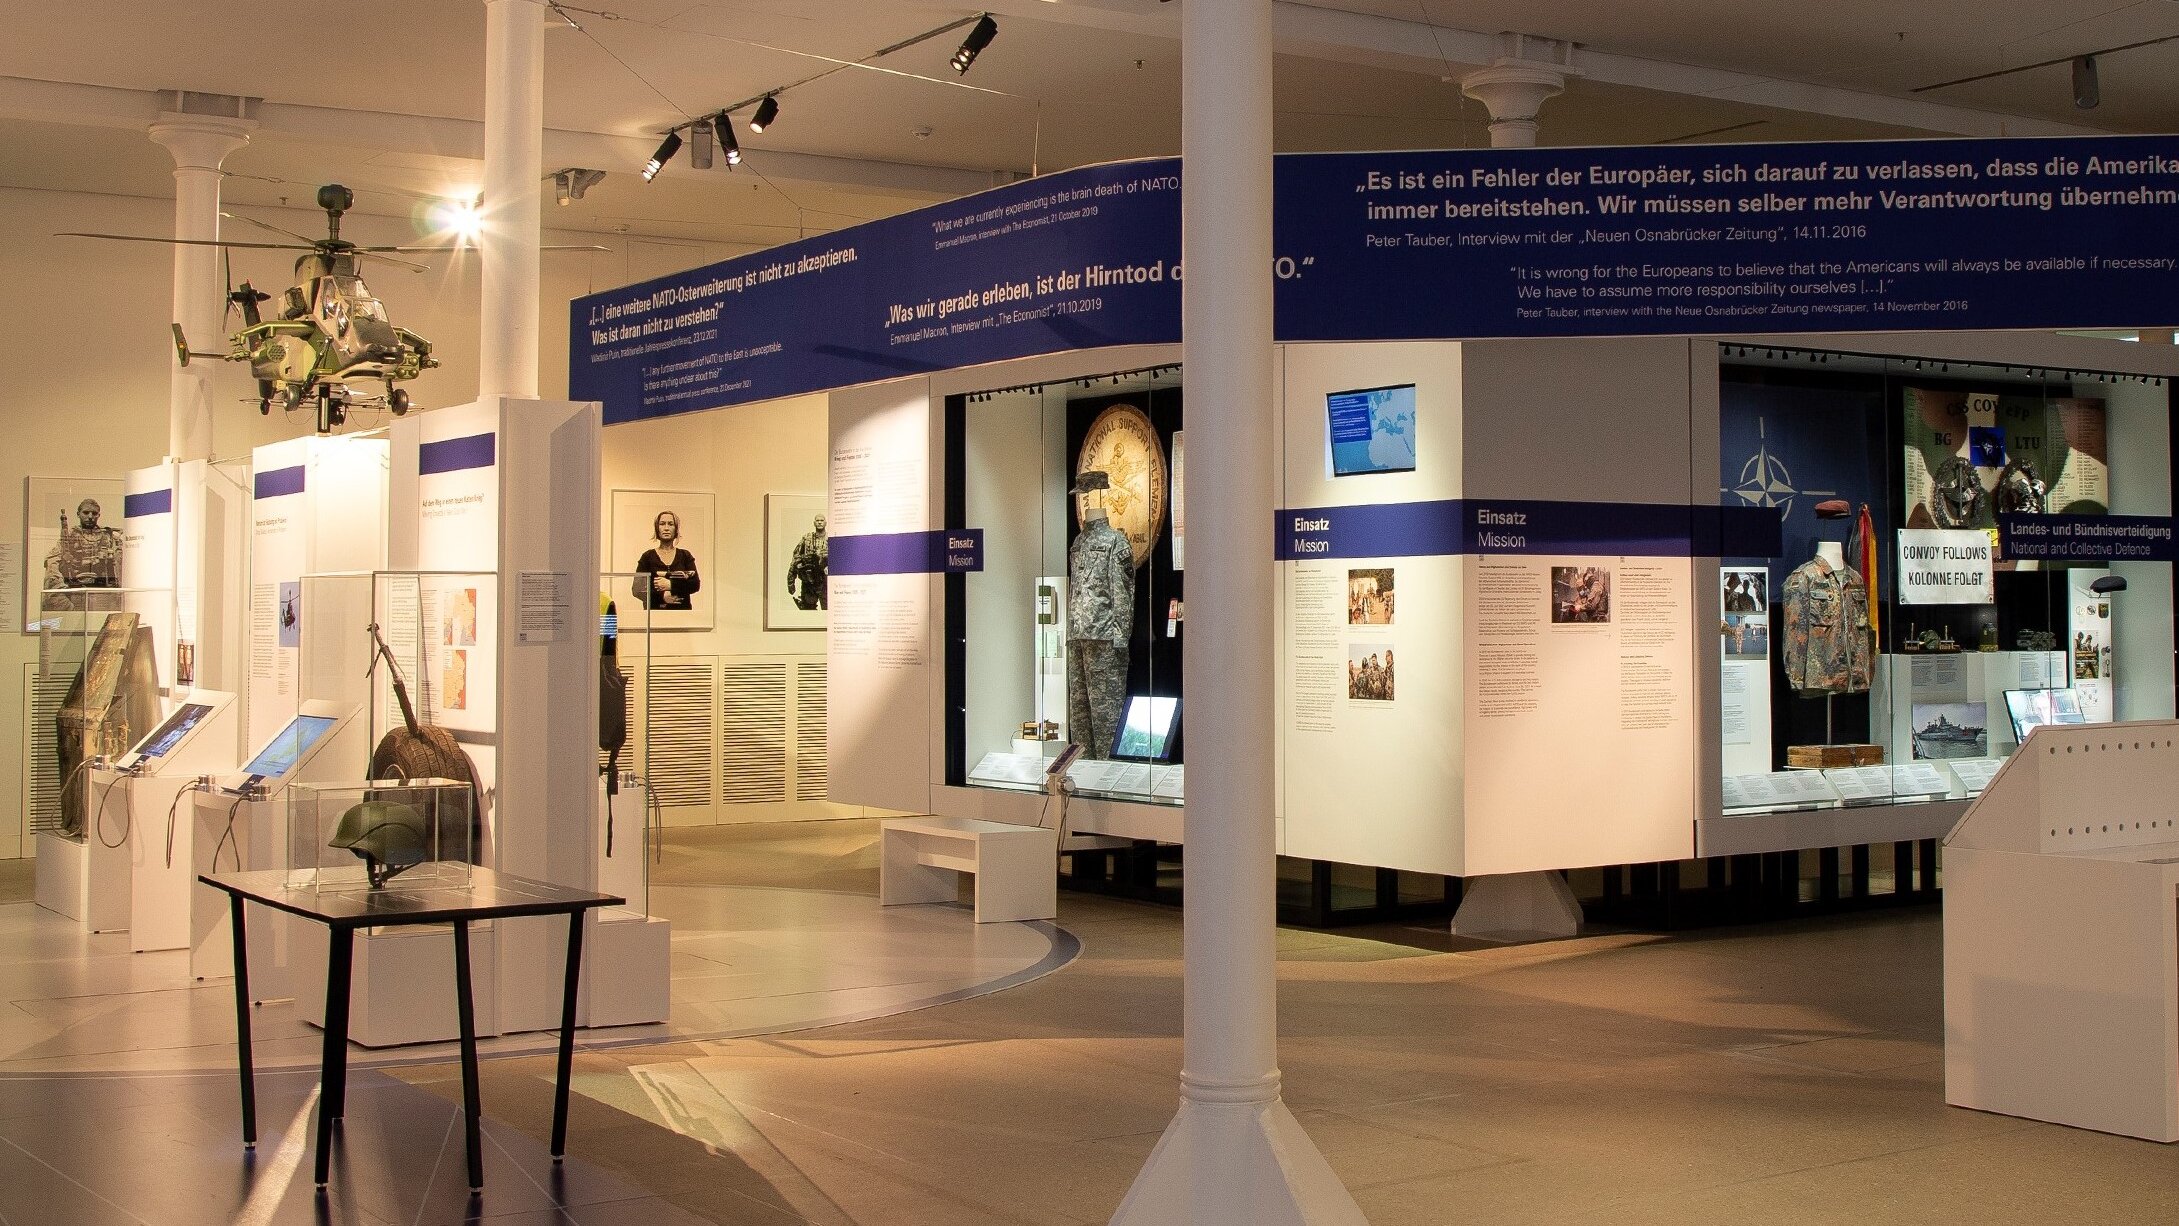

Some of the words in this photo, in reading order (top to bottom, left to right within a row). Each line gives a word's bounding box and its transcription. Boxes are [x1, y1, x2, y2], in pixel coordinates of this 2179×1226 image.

[1400, 170, 1426, 189] ist
[1432, 170, 1464, 188] ein
[1472, 167, 1540, 187] Fehler
[1546, 166, 1581, 186] der
[1590, 166, 1696, 189] Europäer,
[1702, 164, 1747, 184] sich
[1754, 161, 1826, 183] darauf
[1833, 165, 1859, 180] zu
[1866, 160, 1979, 181] verlassen,
[1986, 158, 2038, 177] dass
[2044, 157, 2080, 176] die
[953, 218, 963, 228] we
[964, 216, 975, 227] are
[976, 207, 1004, 223] currently
[1005, 196, 1048, 216] experiencing
[1050, 193, 1057, 205] is
[1058, 190, 1070, 203] the
[1072, 186, 1092, 200] brain
[1095, 182, 1123, 197] death
[1127, 181, 1138, 193] of
[1368, 202, 1439, 220] immer
[1445, 198, 1591, 218] bereitstehen.
[1598, 195, 1637, 214] Wir
[1644, 194, 1731, 214] müssen
[1738, 191, 1806, 212] selber
[1814, 191, 1872, 211] mehr
[1880, 189, 2052, 211] Verantwortung
[2061, 186, 2179, 206] übernehm
[935, 236, 960, 250] Emmanuel
[979, 228, 1000, 240] interview
[1001, 224, 1011, 236] with
[1012, 222, 1022, 233] The
[1051, 214, 1058, 223] 21
[1059, 210, 1080, 222] October
[1082, 206, 1098, 218] 2019
[1366, 234, 1402, 246] Peter
[1405, 233, 1453, 247] Tauber,
[1458, 231, 1521, 246] Interview
[1525, 231, 1546, 244] mit
[1551, 230, 1573, 244] der
[1635, 228, 1721, 242] Osnabrücker
[1793, 226, 1866, 239] 14.11.2016
[1531, 266, 1541, 279] is
[1546, 268, 1588, 281] wrong
[1593, 265, 1612, 278] for
[1617, 265, 1638, 278] the
[1643, 264, 1714, 280] Europeans
[1719, 265, 1732, 276] to
[1736, 262, 1785, 276] believe
[1788, 262, 1815, 275] that
[1820, 262, 1842, 275] the
[1847, 260, 1920, 273] Americans
[1925, 259, 1947, 272] will
[1952, 258, 1999, 274] always
[2004, 258, 2022, 271] be
[2026, 257, 2085, 271] available
[2090, 256, 2099, 269] if
[2103, 258, 2178, 271] necessary.
[606, 304, 621, 320] eine
[623, 298, 651, 315] weitere
[653, 278, 743, 309] NATO-Osterweiterung
[746, 270, 757, 286] ist
[760, 266, 782, 284] nicht
[784, 264, 795, 276] zu
[798, 248, 858, 274] akzeptieren.
[917, 298, 935, 317] wir
[939, 290, 979, 319] gerade
[983, 282, 1033, 305] erleben,
[1037, 276, 1053, 295] ist
[1057, 270, 1081, 292] der
[1086, 260, 1163, 288] Hirntod
[1517, 286, 1541, 299] We
[1546, 285, 1577, 298] have
[1583, 286, 1595, 297] to
[1599, 286, 1652, 297] assume
[1658, 286, 1693, 297] more
[1697, 282, 1786, 298] responsibility
[1790, 280, 1856, 294] ourselves
[1517, 308, 1542, 318] Peter
[1545, 308, 1580, 318] Tauber,
[1583, 306, 1629, 316] interview
[1632, 306, 1652, 316] with
[1656, 306, 1672, 316] the
[1676, 306, 1702, 316] Neue
[1705, 304, 1768, 316] Osnabrücker
[1771, 304, 1809, 316] Zeitung
[1812, 304, 1870, 314] newspaper,
[1874, 302, 1885, 311] 14
[1888, 302, 1940, 311] November
[1943, 301, 1968, 311] 2016
[891, 327, 923, 345] Emmanuel
[924, 323, 949, 339] Macron,
[951, 319, 980, 334] Interview
[983, 315, 994, 328] mit
[1058, 298, 1101, 315] 21.10.2019
[592, 330, 607, 346] Was
[609, 327, 618, 342] ist
[620, 325, 641, 340] daran
[643, 320, 663, 335] nicht
[664, 318, 673, 330] zu
[734, 349, 744, 360] East
[1085, 421, 1115, 471] NATIONAL
[1935, 433, 1952, 446] BG
[2016, 436, 2041, 449] LTU
[1295, 518, 1329, 532] Einsatz
[1478, 509, 1527, 525] Einsatz
[1478, 532, 1525, 548] Mission
[2011, 523, 2050, 536] Landes-
[2053, 524, 2071, 536] und
[2075, 523, 2171, 540] Bündnisverteidigung
[949, 538, 974, 549] Einsatz
[1295, 538, 1329, 553] Mission
[2011, 542, 2048, 555] National
[2051, 542, 2068, 555] and
[2070, 542, 2112, 555] Collective
[2115, 542, 2150, 556] Defence
[949, 554, 974, 566] Mission
[1904, 546, 1940, 560] CONVOY
[1943, 547, 1987, 560] FOLLOWS
[1909, 572, 1952, 586] KOLONNE
[1955, 572, 1983, 586] FOLGT
